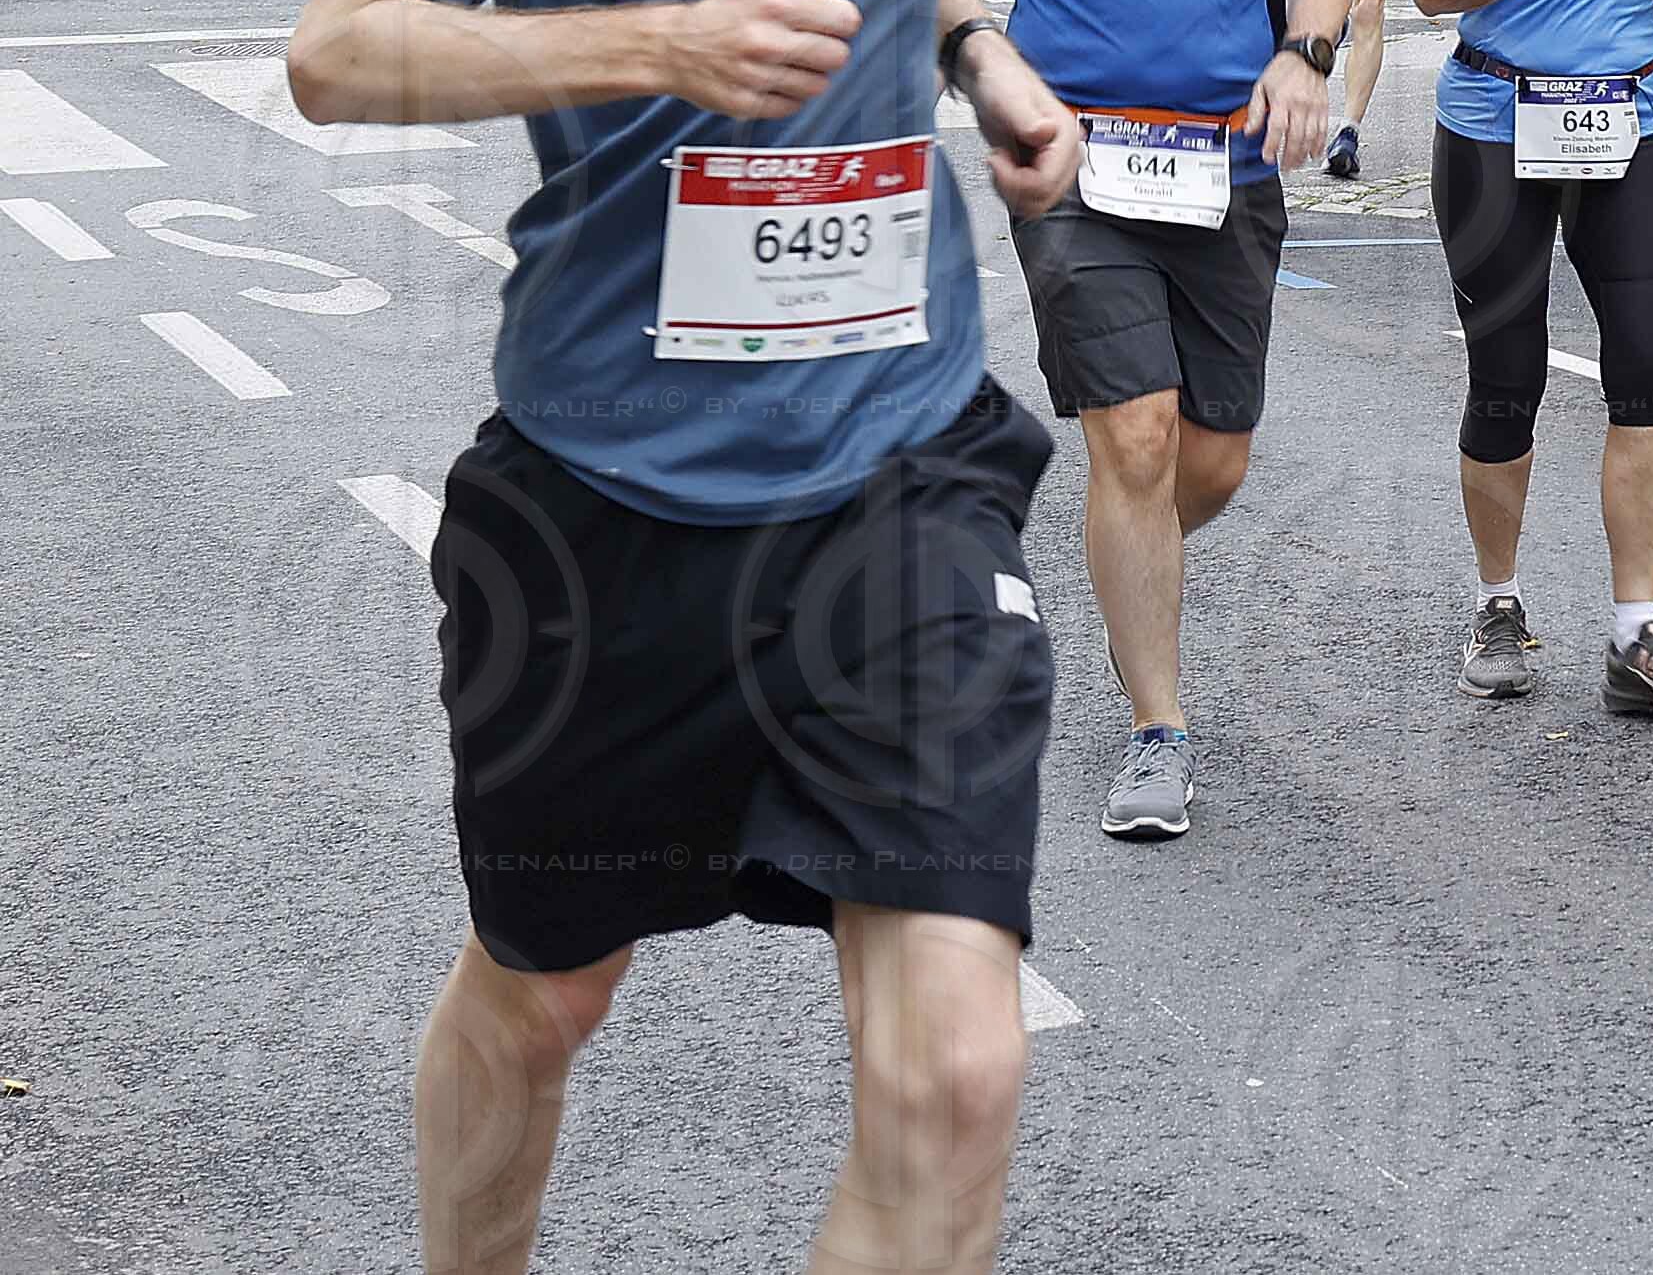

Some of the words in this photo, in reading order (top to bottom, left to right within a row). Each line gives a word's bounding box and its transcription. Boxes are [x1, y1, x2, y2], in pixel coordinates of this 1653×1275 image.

[1549, 81, 1584, 92] GRAZ
[1562, 109, 1610, 133] 643
[1560, 143, 1613, 154] Elisabeth
[1126, 152, 1178, 179] 644
[754, 213, 872, 265] 6493
